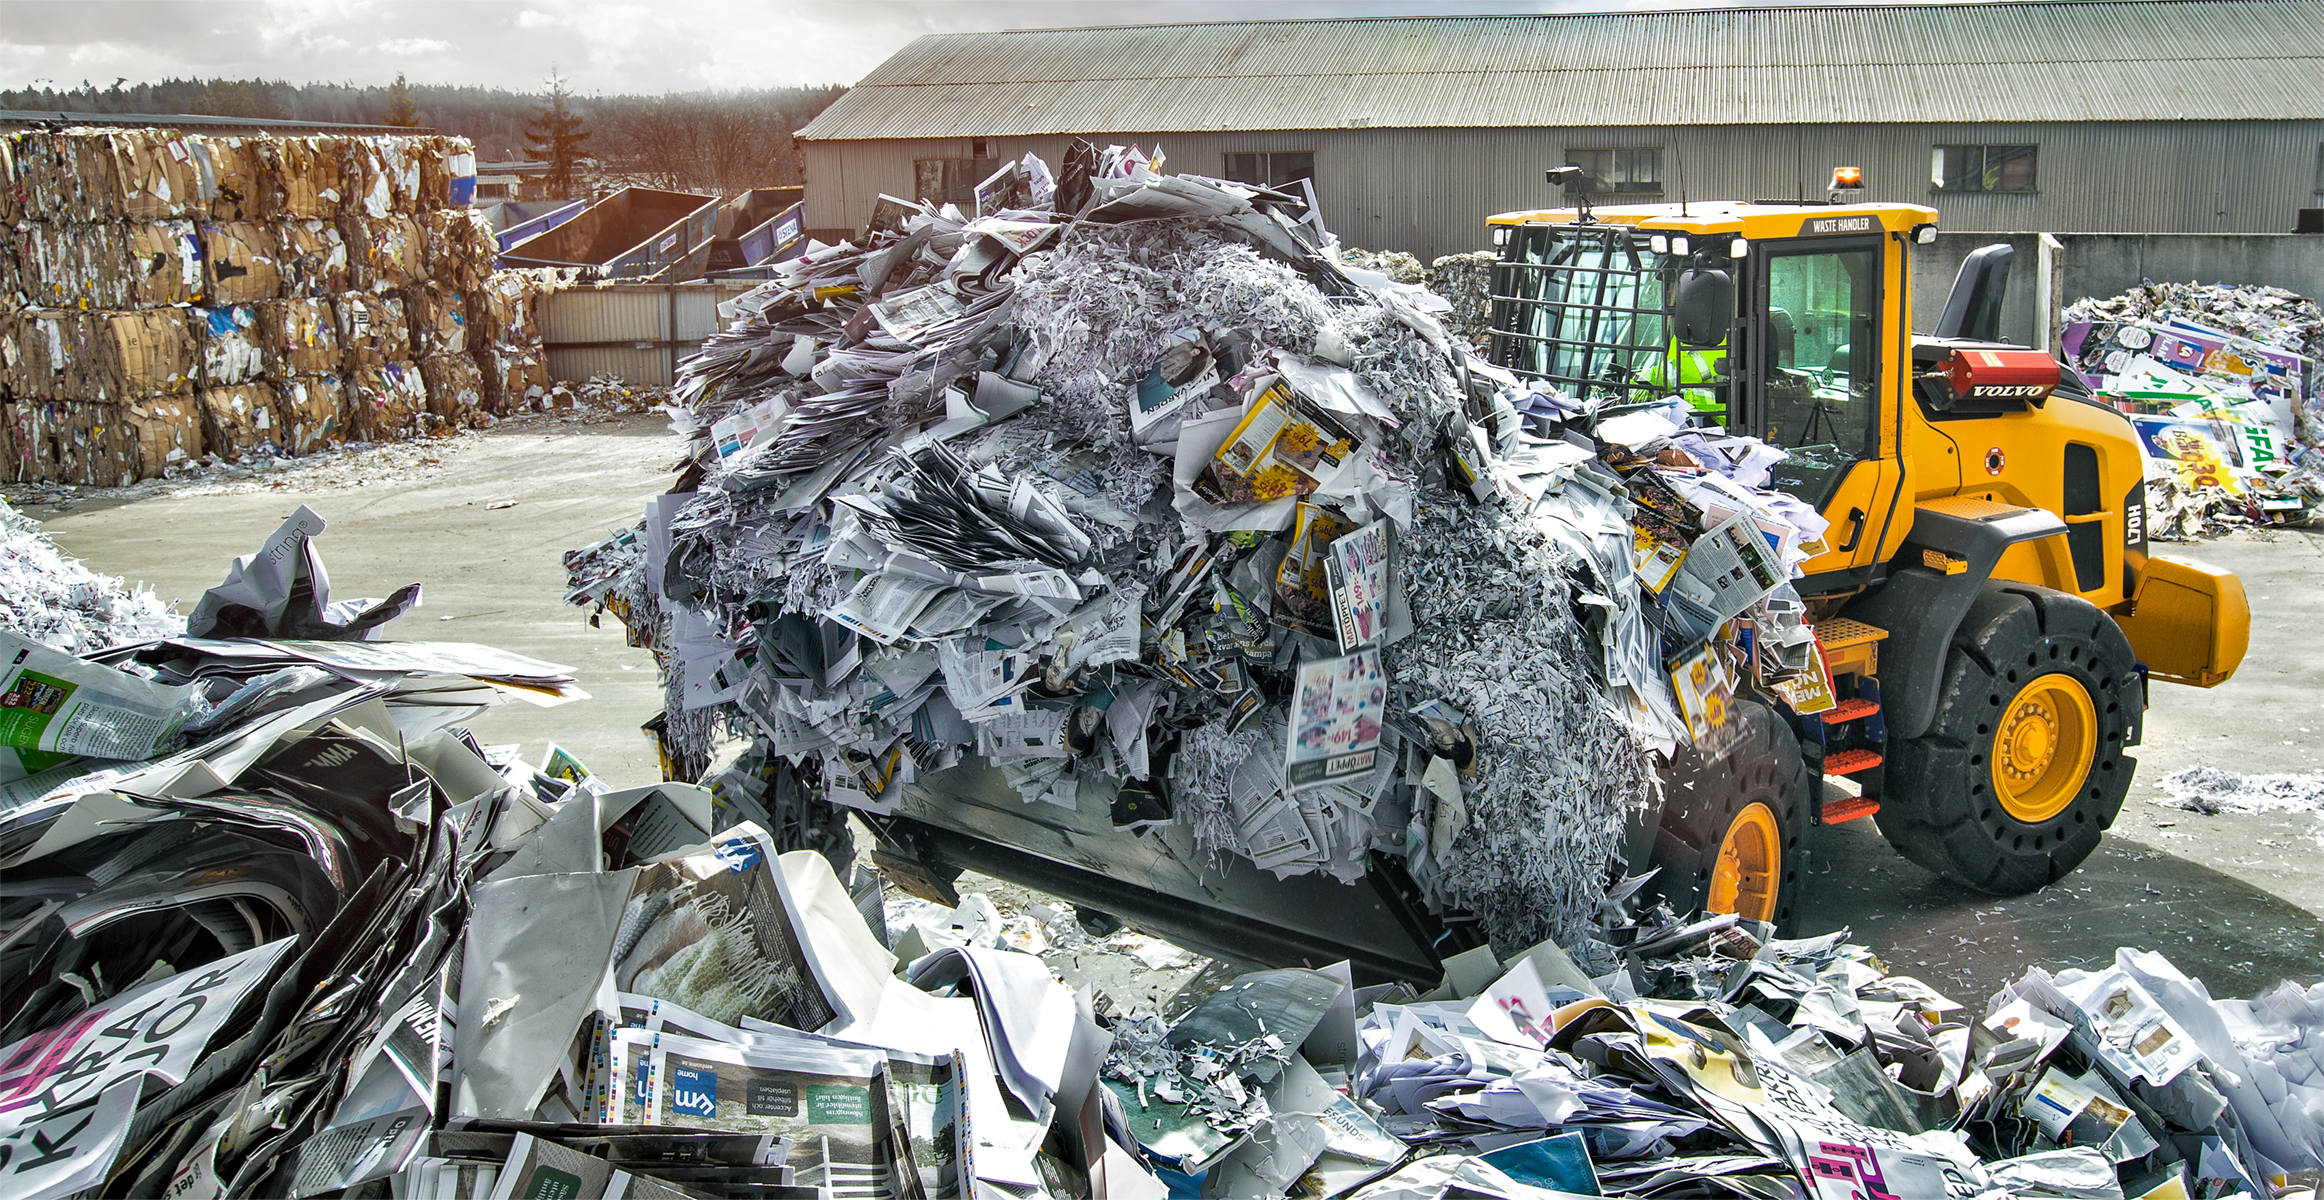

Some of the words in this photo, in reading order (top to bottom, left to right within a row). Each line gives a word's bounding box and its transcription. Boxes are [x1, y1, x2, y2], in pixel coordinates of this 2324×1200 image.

[782, 222, 797, 239] STENA
[1813, 219, 1837, 233] WASTE
[1838, 218, 1870, 231] HANDLER
[1973, 385, 2044, 397] VOLVO
[2127, 504, 2142, 545] L70H
[1337, 591, 1356, 645] MATÖPPET
[1329, 752, 1373, 773] MATÖPPET
[1365, 783, 1377, 796] M
[681, 1060, 713, 1070] emhome.se
[676, 1068, 699, 1080] home
[751, 1102, 766, 1112] och
[768, 1103, 792, 1113] Accenter
